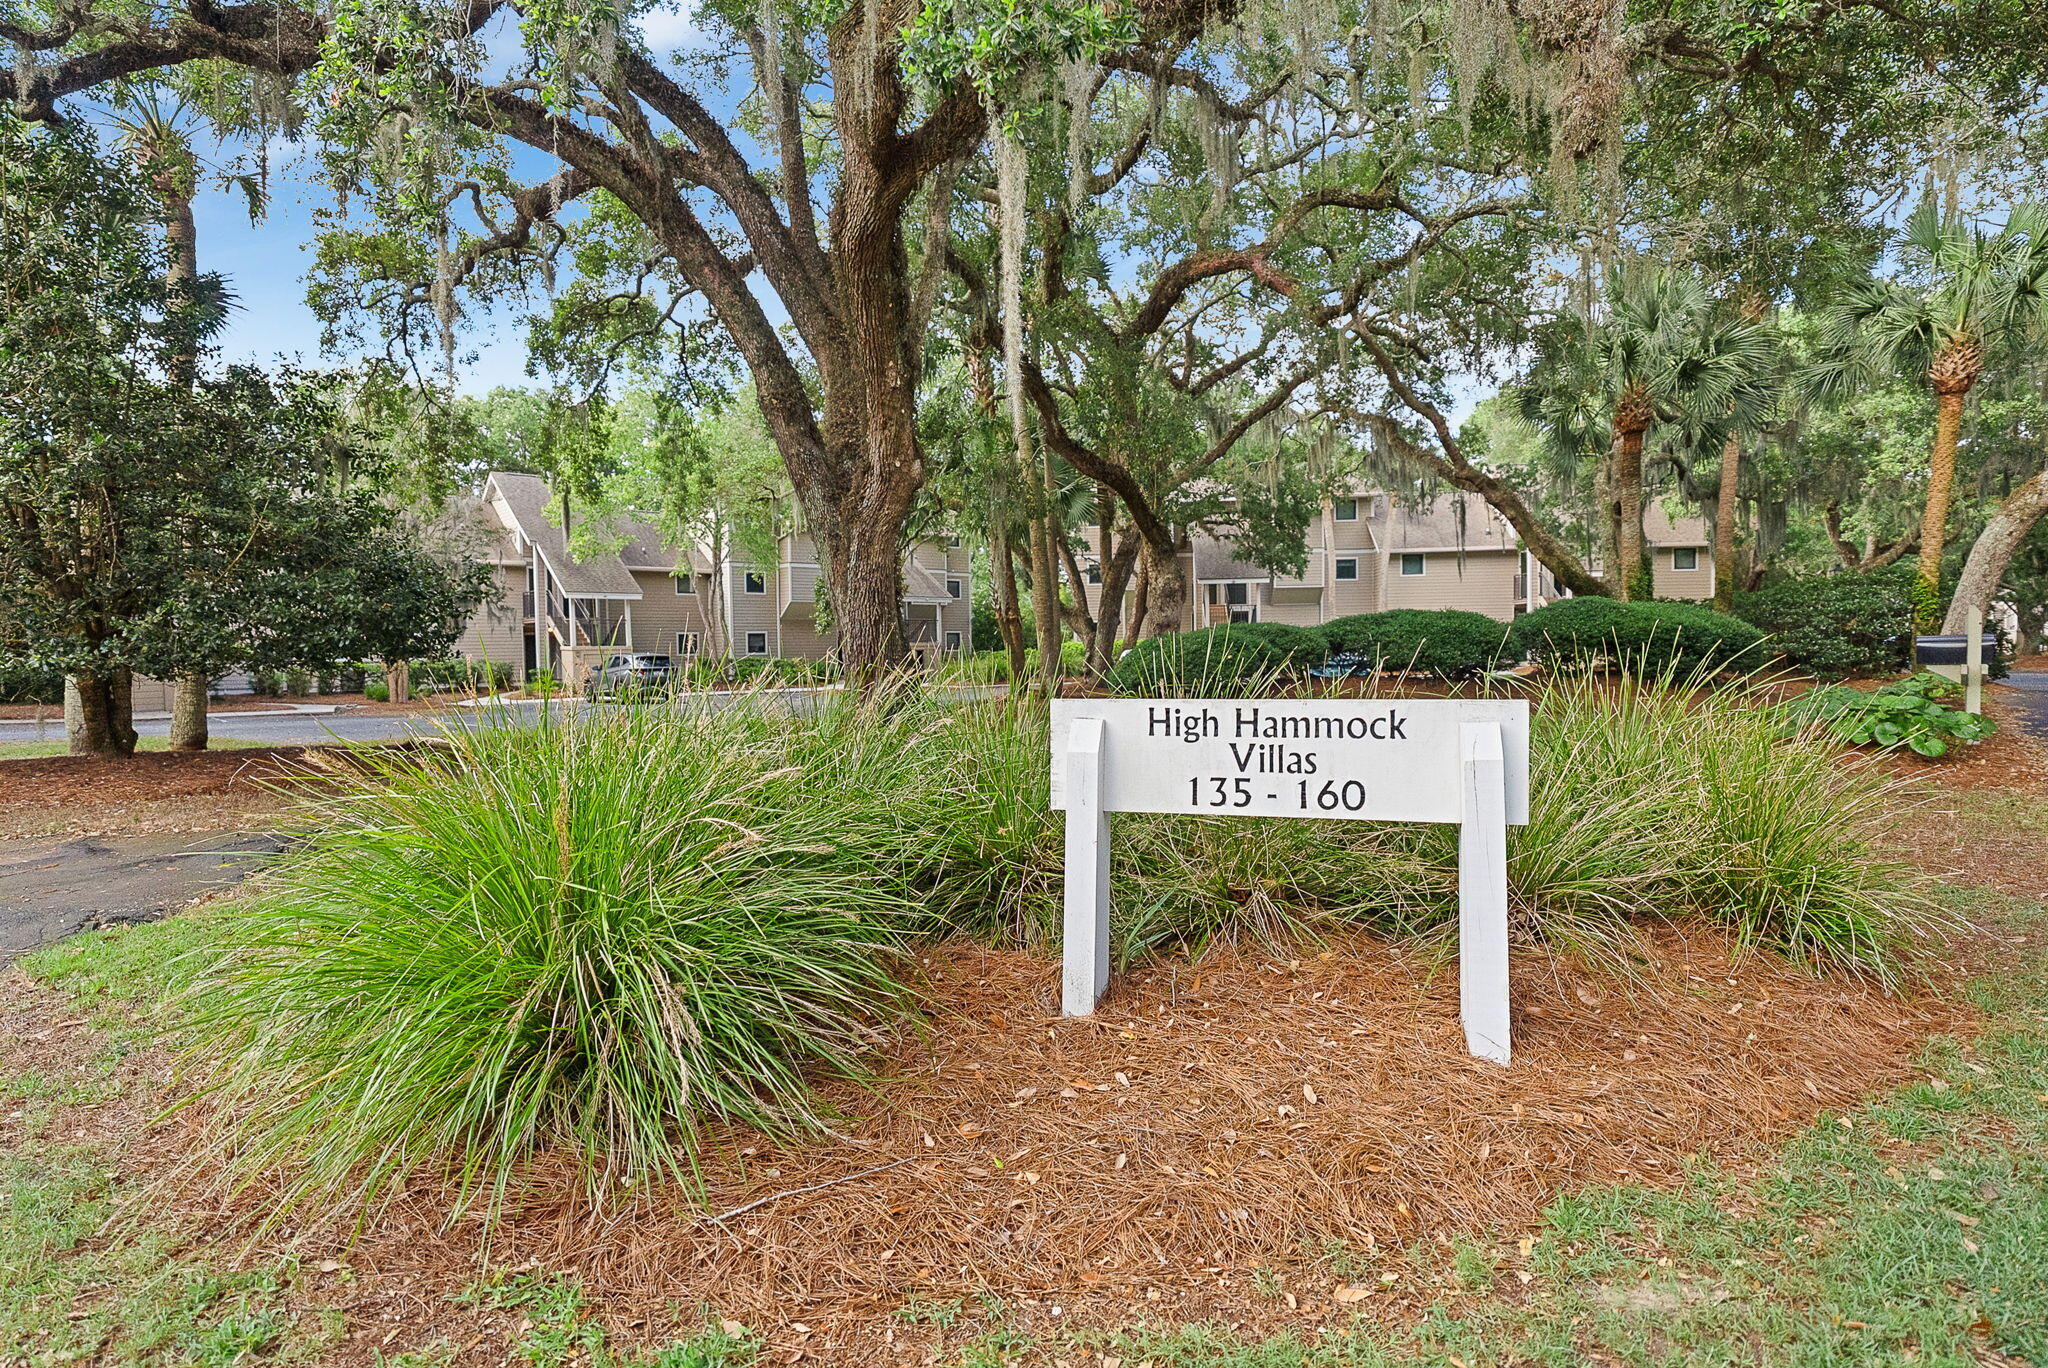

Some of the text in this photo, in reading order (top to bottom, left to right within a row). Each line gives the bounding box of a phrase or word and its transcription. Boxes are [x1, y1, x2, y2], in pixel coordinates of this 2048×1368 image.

[1148, 706, 1408, 743] High Hammock
[1228, 742, 1317, 775] Villas
[1189, 776, 1252, 808] 135
[1298, 779, 1367, 812] 160
